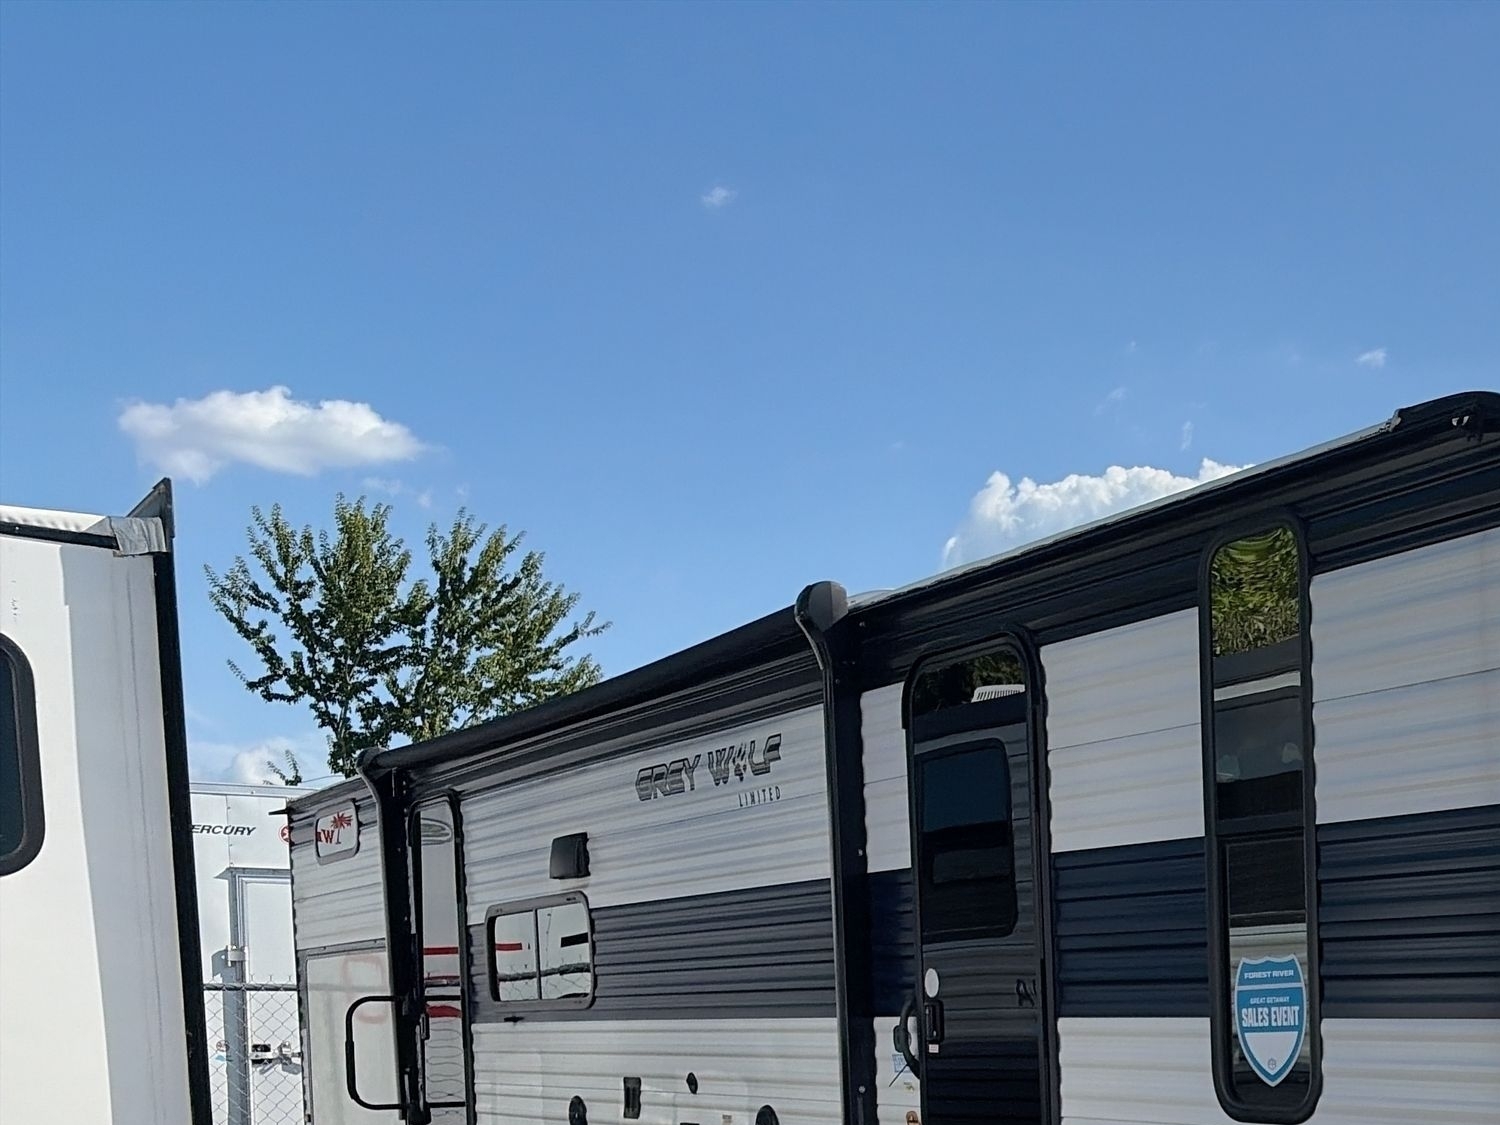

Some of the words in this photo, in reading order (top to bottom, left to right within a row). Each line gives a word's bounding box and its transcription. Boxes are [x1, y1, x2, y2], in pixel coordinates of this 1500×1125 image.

[635, 753, 702, 801] GREY
[738, 785, 781, 808] LIMITED
[190, 824, 256, 836] ERCURY
[1243, 970, 1272, 980] FOREST
[1272, 969, 1294, 978] RIVER
[1241, 1007, 1270, 1028] SALES
[1270, 1006, 1300, 1027] EVENT
